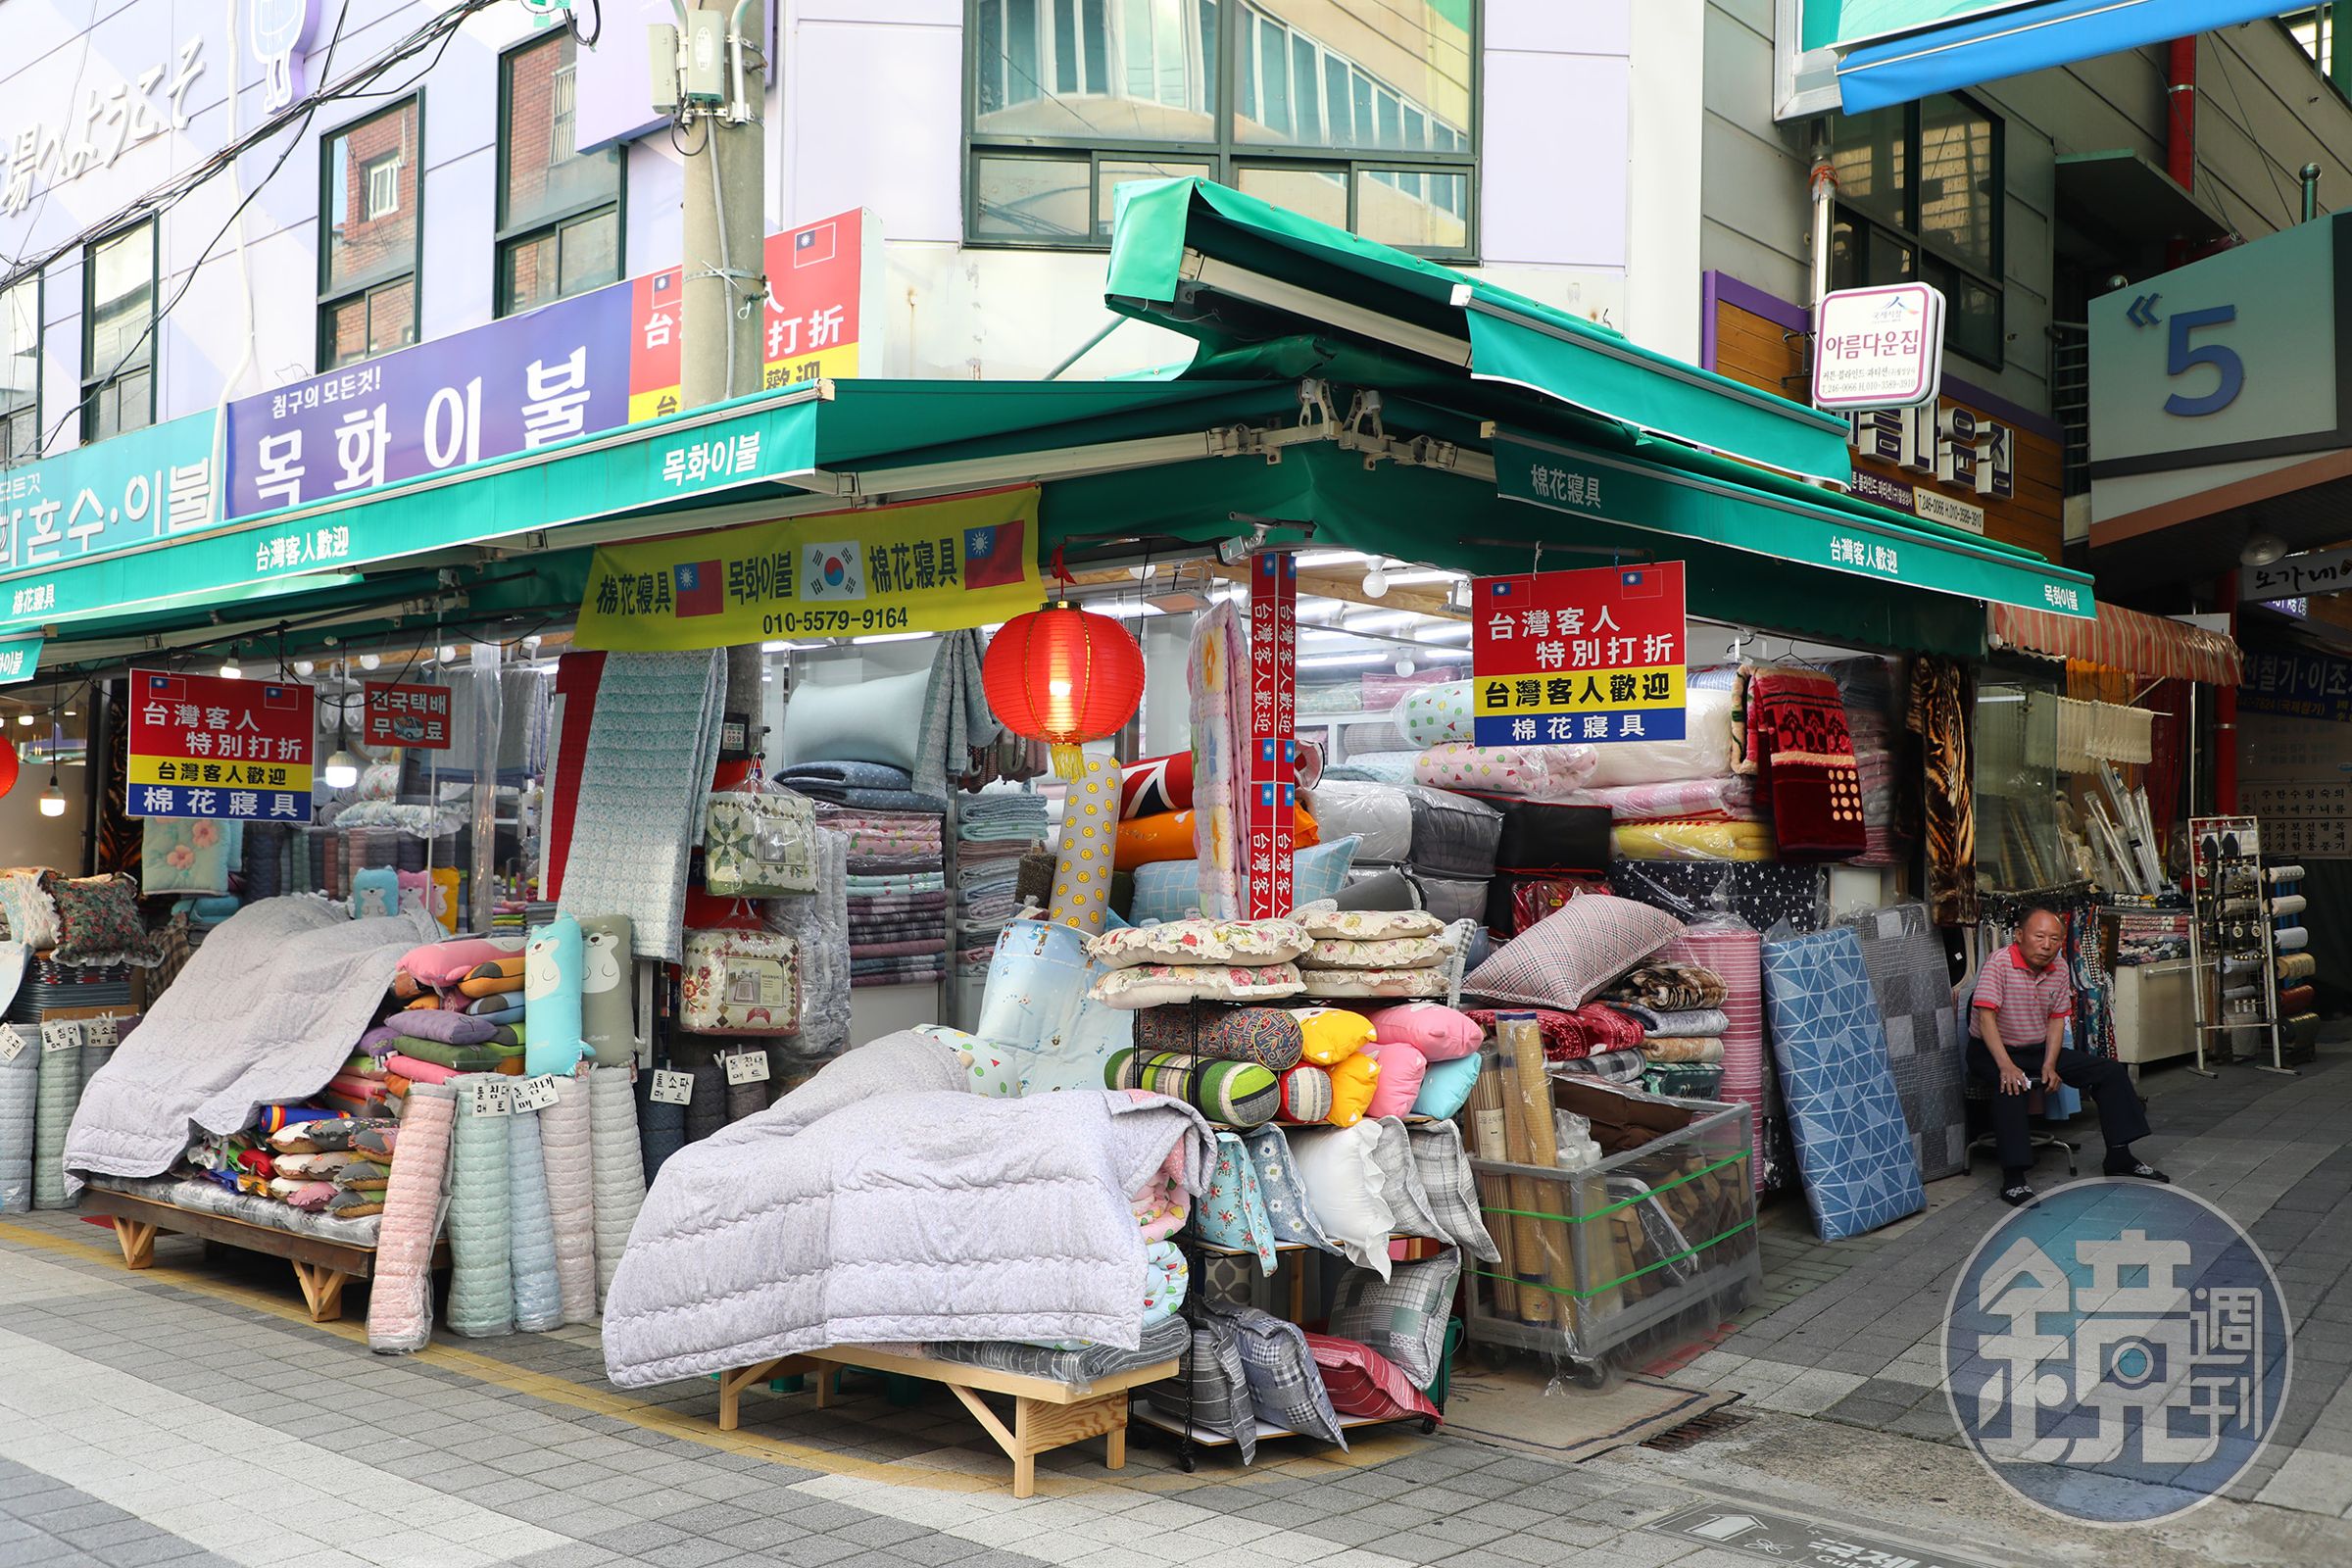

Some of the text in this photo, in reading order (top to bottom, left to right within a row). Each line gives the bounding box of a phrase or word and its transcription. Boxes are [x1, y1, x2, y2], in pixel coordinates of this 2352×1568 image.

[0, 32, 206, 218] 場へようこそ
[768, 304, 845, 359] 打折
[1826, 329, 1919, 360] 아름다운집
[2163, 304, 2244, 417] 5
[272, 366, 381, 419] 침구의 모든것!
[662, 431, 760, 487] 목화이불
[256, 525, 349, 573] 台灣客人歡迎
[1829, 535, 1899, 576] 台灣客人歡迎
[728, 551, 794, 606] 목화이불
[2043, 582, 2080, 612] 목화이불
[762, 606, 908, 636] 010-5579-9164
[1488, 605, 1621, 641] 台灣客人
[1536, 633, 1674, 669] 特別打折
[369, 689, 448, 715] 전국택배
[1486, 672, 1670, 709] 台灣客人歡迎
[143, 701, 261, 733] 台灣客人
[1512, 714, 1645, 742] 棉花寢具
[186, 731, 303, 761] 特別打折
[157, 760, 286, 786] 台灣客人歡迎
[144, 787, 298, 818] 棉花寢具
